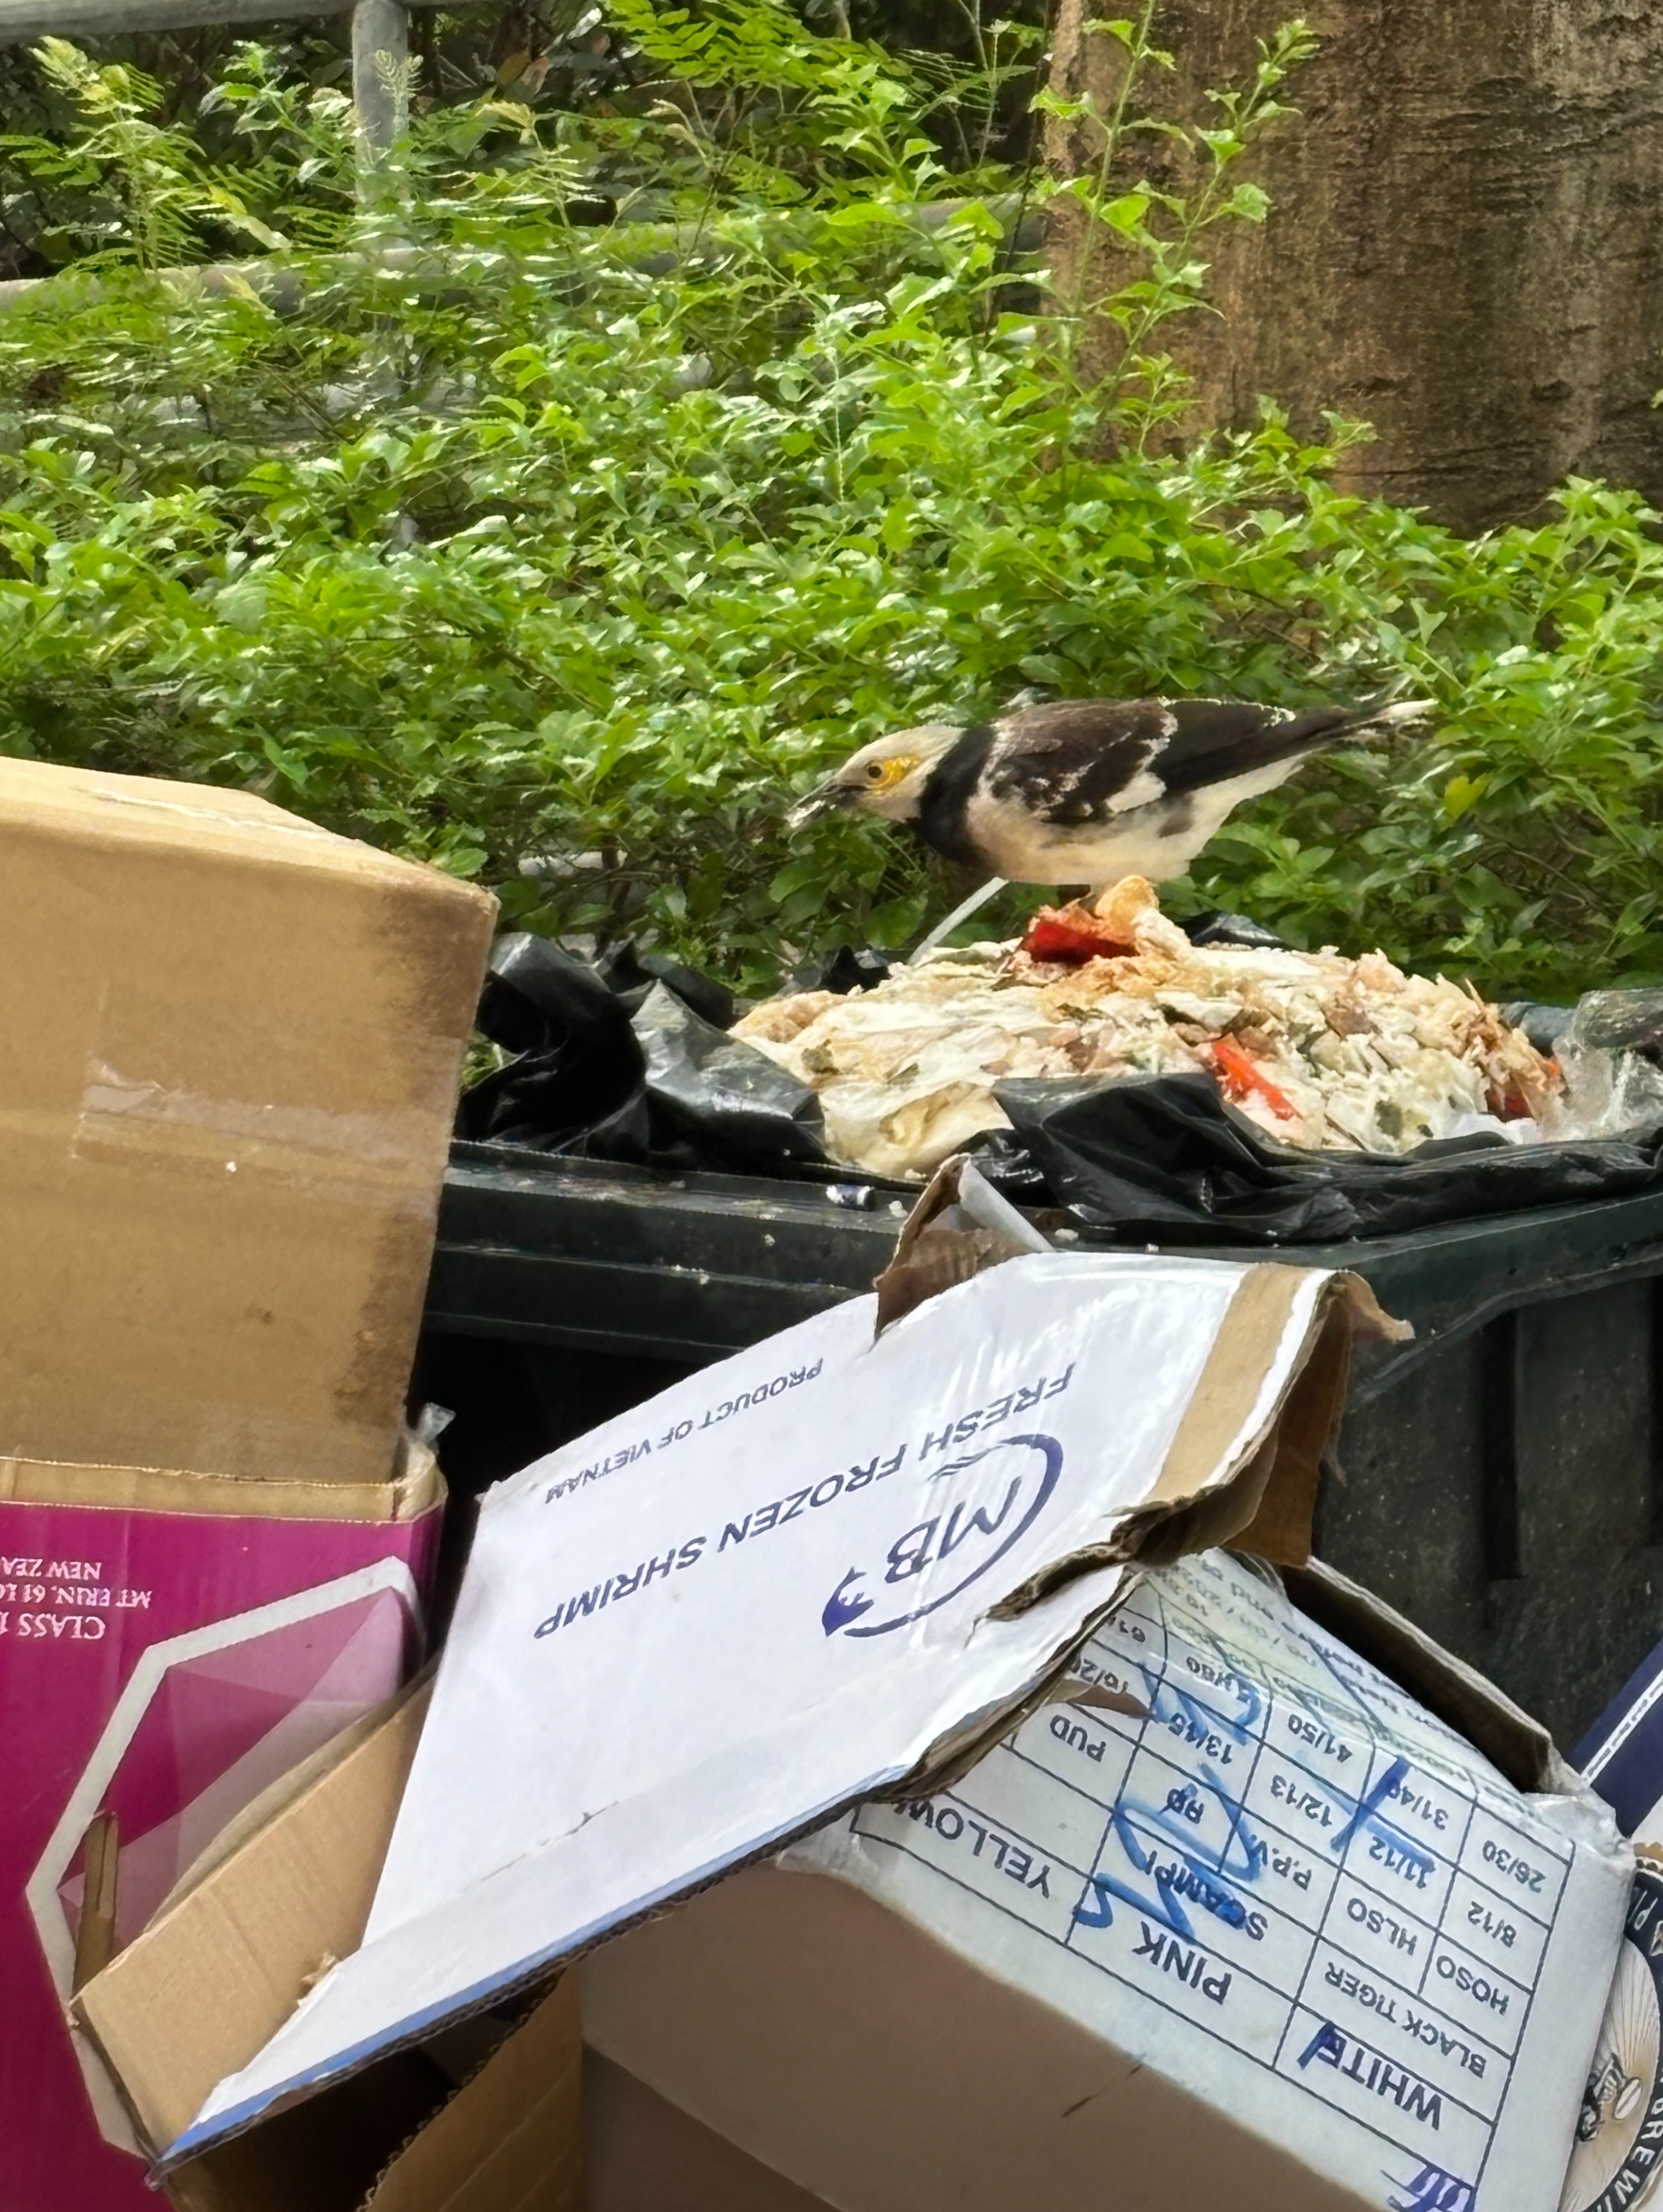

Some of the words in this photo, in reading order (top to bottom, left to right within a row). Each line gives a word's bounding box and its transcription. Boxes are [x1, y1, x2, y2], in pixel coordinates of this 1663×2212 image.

[698, 1358, 824, 1430] PRODUCT
[919, 1362, 1076, 1462] FRESH
[657, 1420, 694, 1449] OF
[545, 1440, 651, 1504] VIETNAM
[718, 1444, 908, 1553] FROZEN
[22, 1585, 46, 1604] 61
[45, 1560, 103, 1580] NEW
[115, 1589, 152, 1609] MT
[534, 1537, 706, 1638] SHRIMP
[17, 1612, 106, 1639] CLASS
[1049, 1714, 1107, 1762] PUD
[1167, 1712, 1232, 1765] 13/15
[1288, 1713, 1353, 1763] 41/50
[1270, 1774, 1333, 1827] 12/13
[1147, 1850, 1269, 1941] SCAMPI
[1481, 1840, 1546, 1894] 26/30
[1346, 1898, 1418, 1956] HLSO
[1466, 1900, 1517, 1949] 8/12
[1132, 1920, 1232, 2006] PINK
[1324, 1961, 1397, 2023] TIGER
[1435, 1955, 1511, 2015] HOSO
[1402, 2009, 1487, 2078] BLACK
[1317, 2030, 1443, 2131] WHITE
